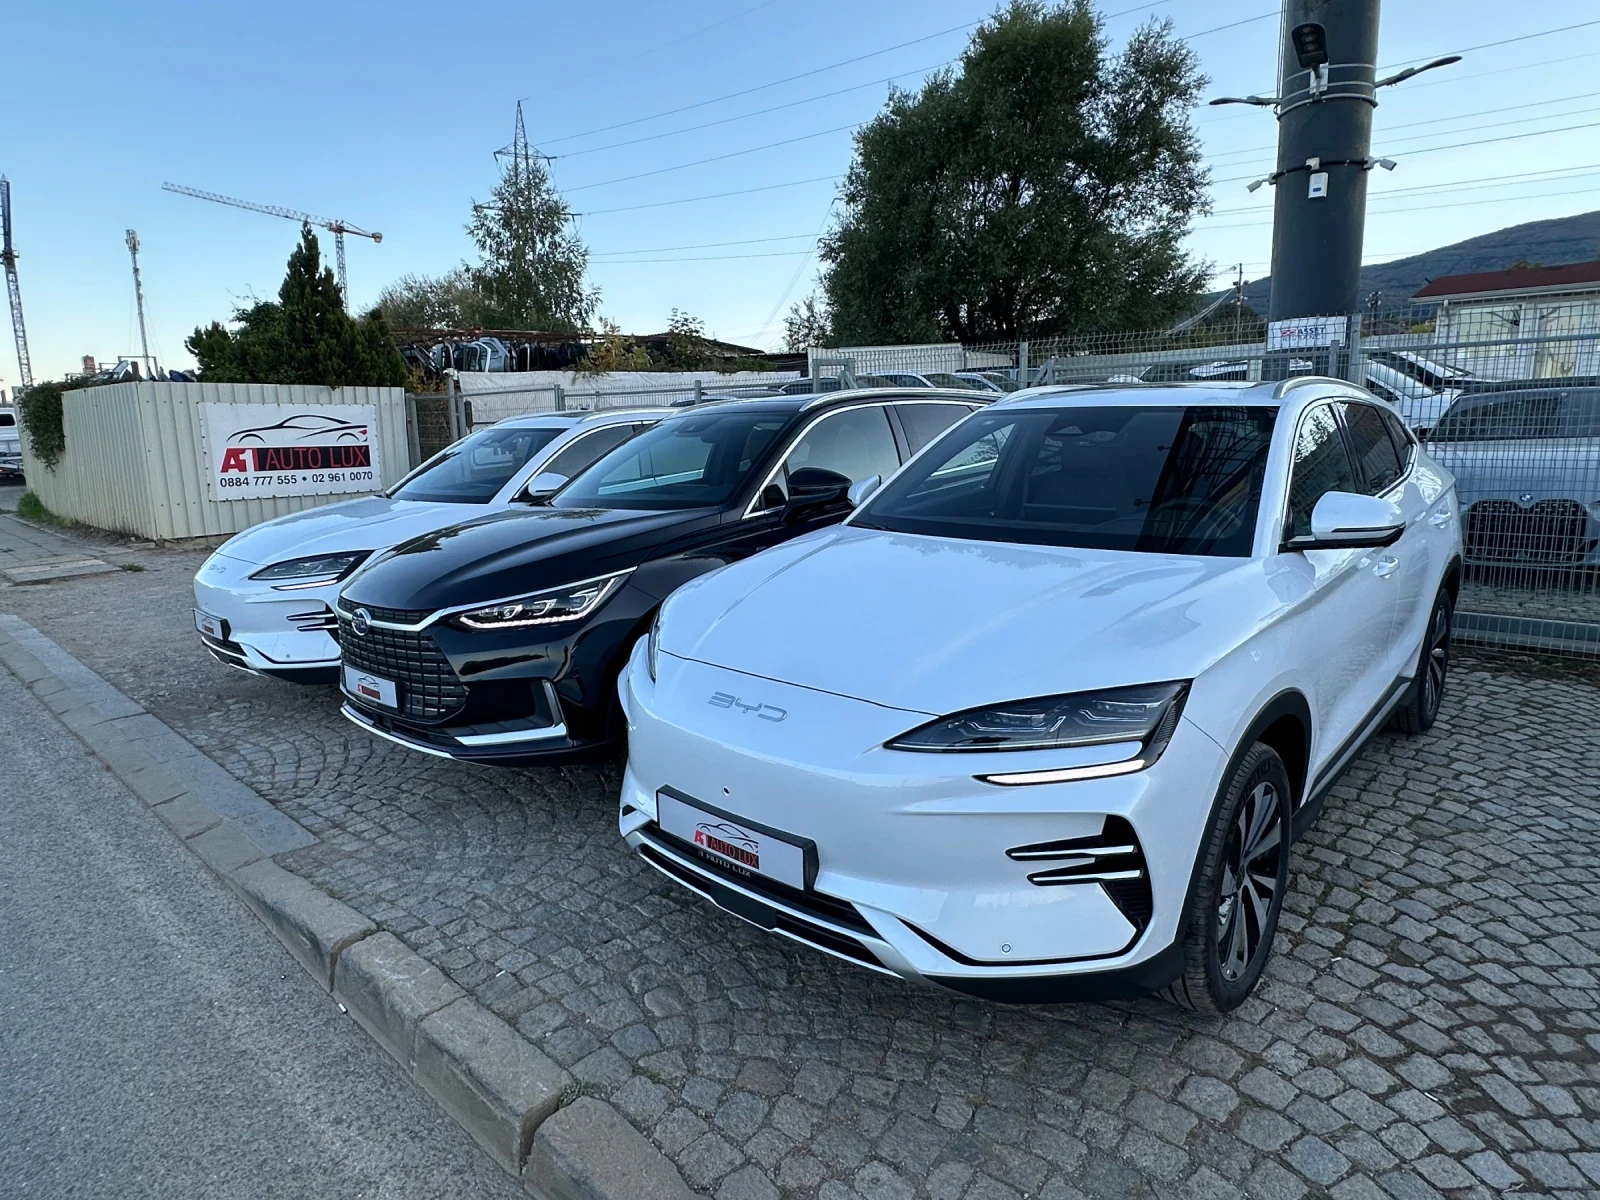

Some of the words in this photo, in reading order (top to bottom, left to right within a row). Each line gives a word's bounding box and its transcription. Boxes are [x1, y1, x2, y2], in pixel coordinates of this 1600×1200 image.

[220, 447, 258, 473] A1
[265, 447, 322, 470] AUTO
[329, 446, 369, 468] LUX
[220, 477, 249, 488] 0884
[253, 476, 273, 486] 777
[277, 475, 297, 485] 555
[312, 473, 325, 483] 02
[328, 472, 345, 482] 961
[350, 471, 373, 481] 0070
[707, 691, 787, 722] BYD
[695, 830, 708, 847] A1
[710, 837, 736, 858] AUTO
[738, 848, 758, 869] LUX
[732, 865, 751, 878] LUX
